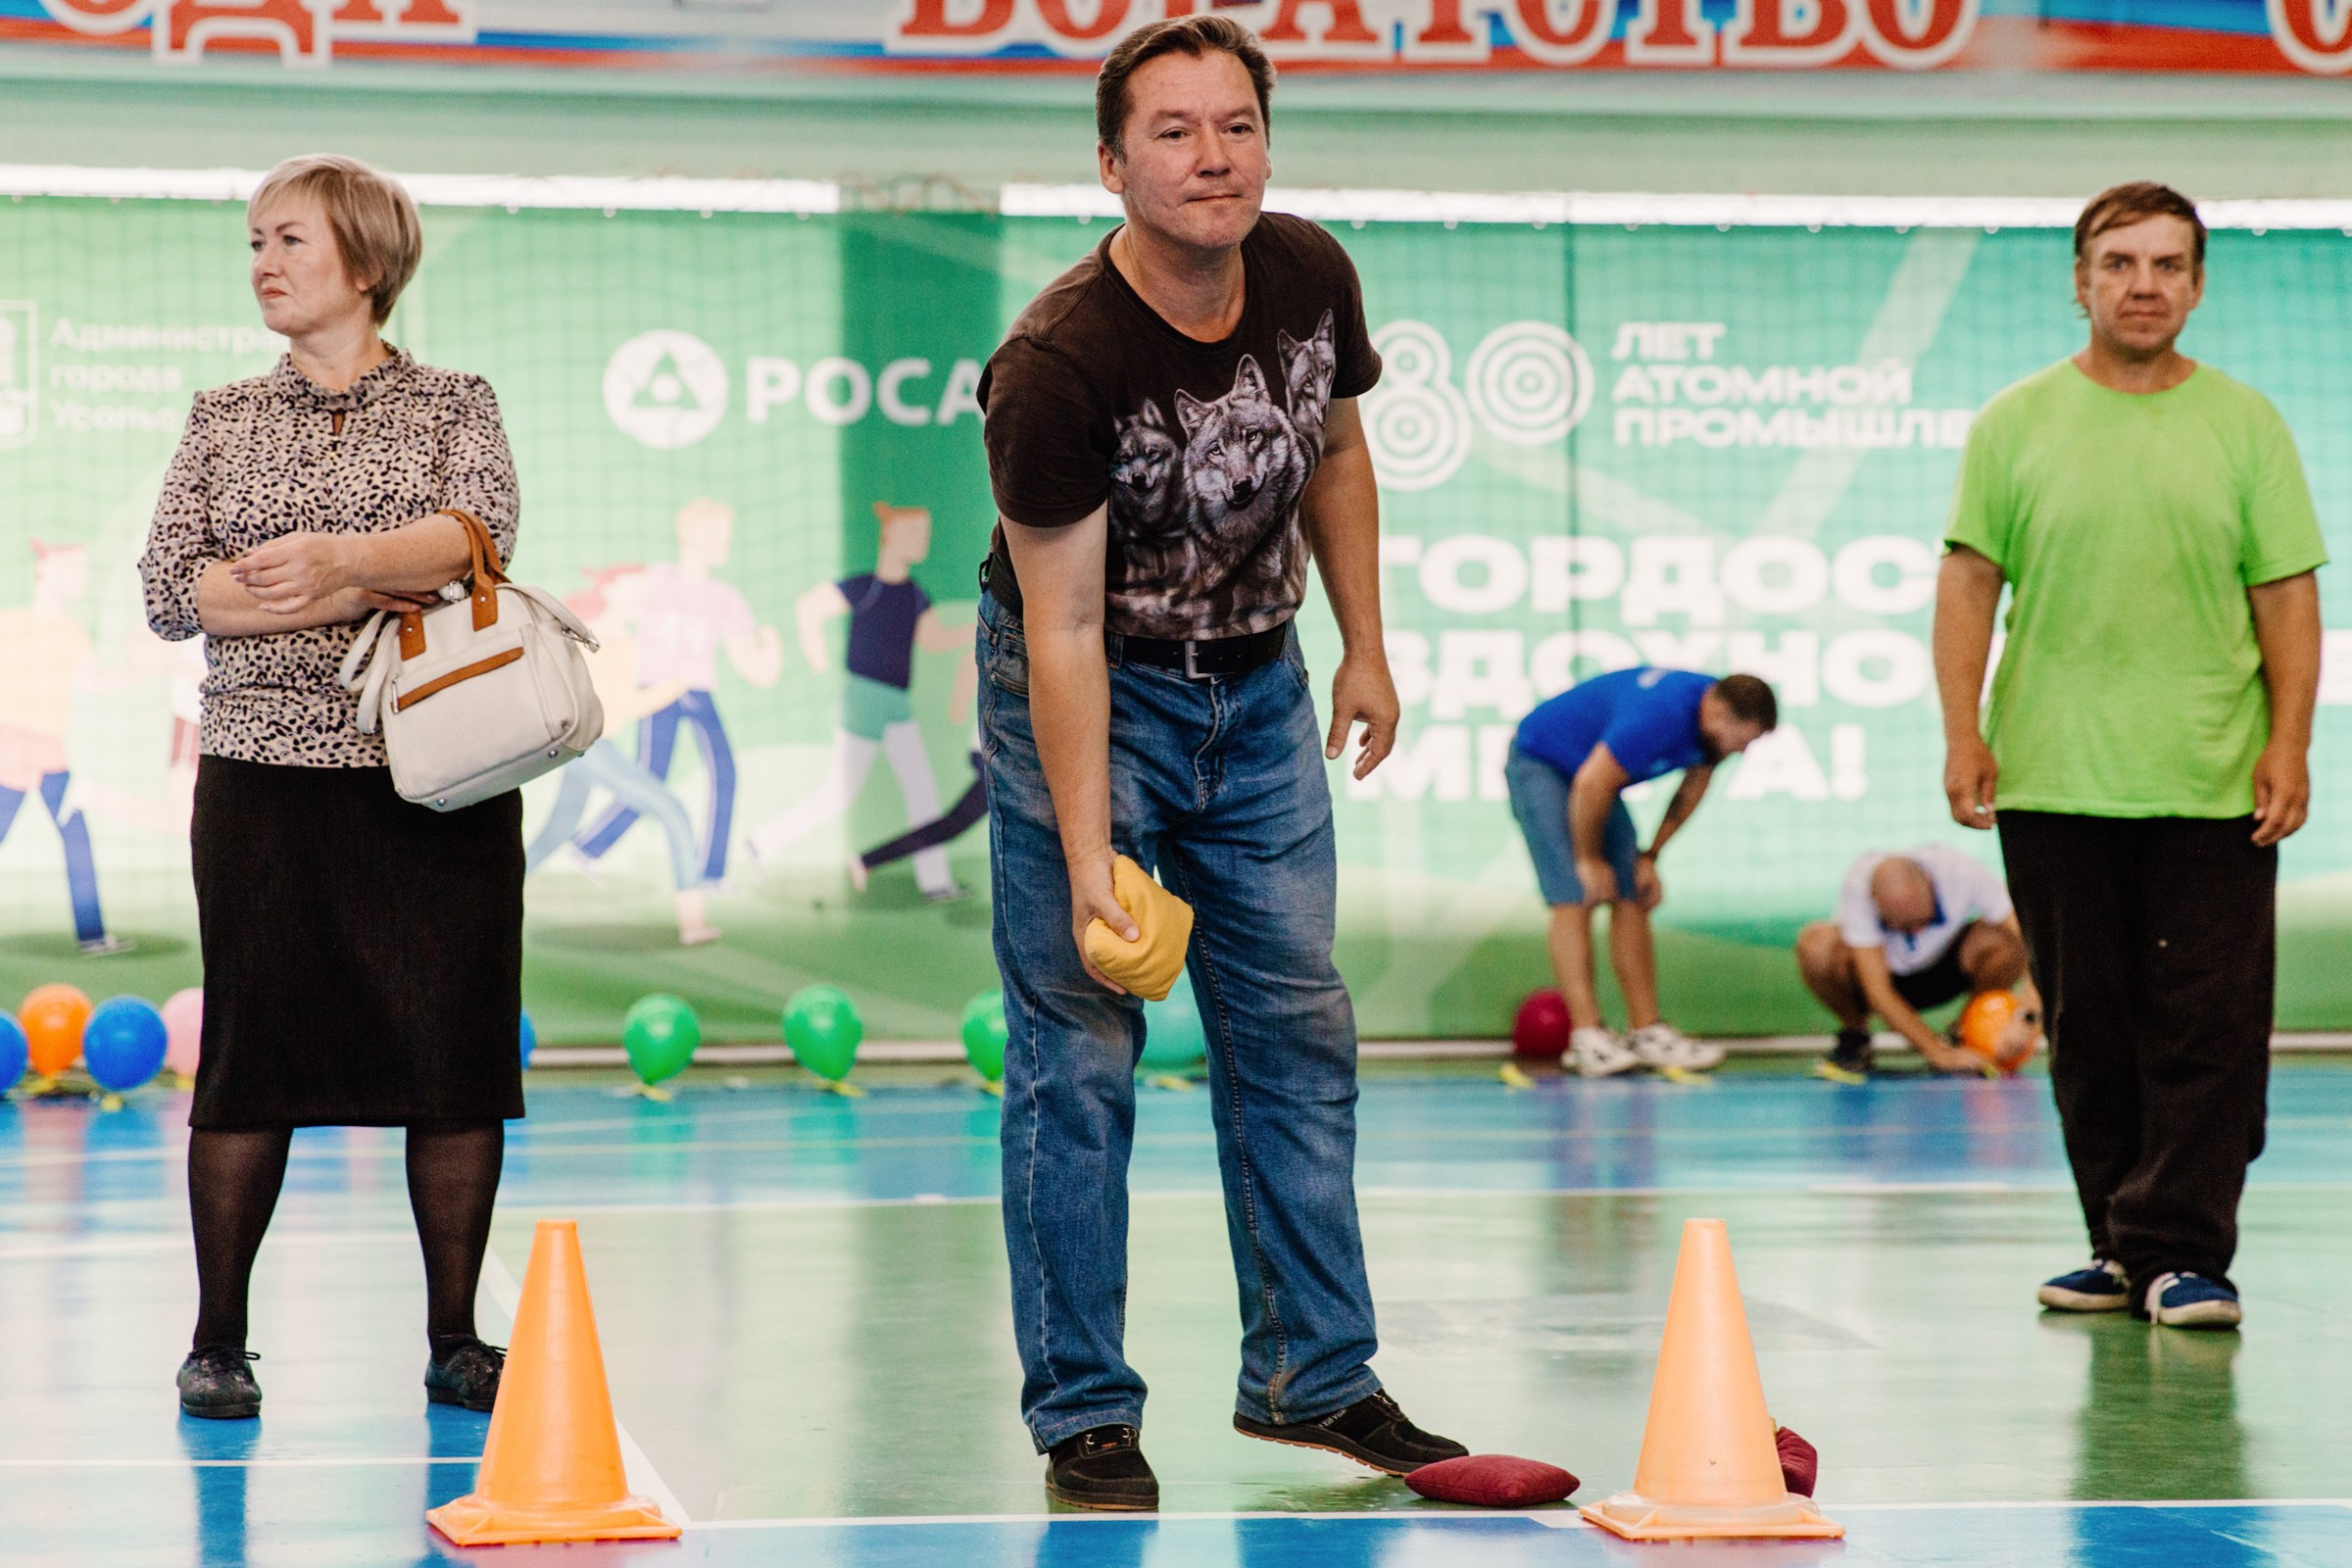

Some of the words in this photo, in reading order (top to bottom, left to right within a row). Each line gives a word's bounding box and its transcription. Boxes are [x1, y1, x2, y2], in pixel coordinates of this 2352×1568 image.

[1610, 321, 1726, 361] ЛЕТ
[50, 363, 183, 394] города
[1611, 357, 1914, 405] АТОМНОЙ
[1360, 318, 1594, 492] 80
